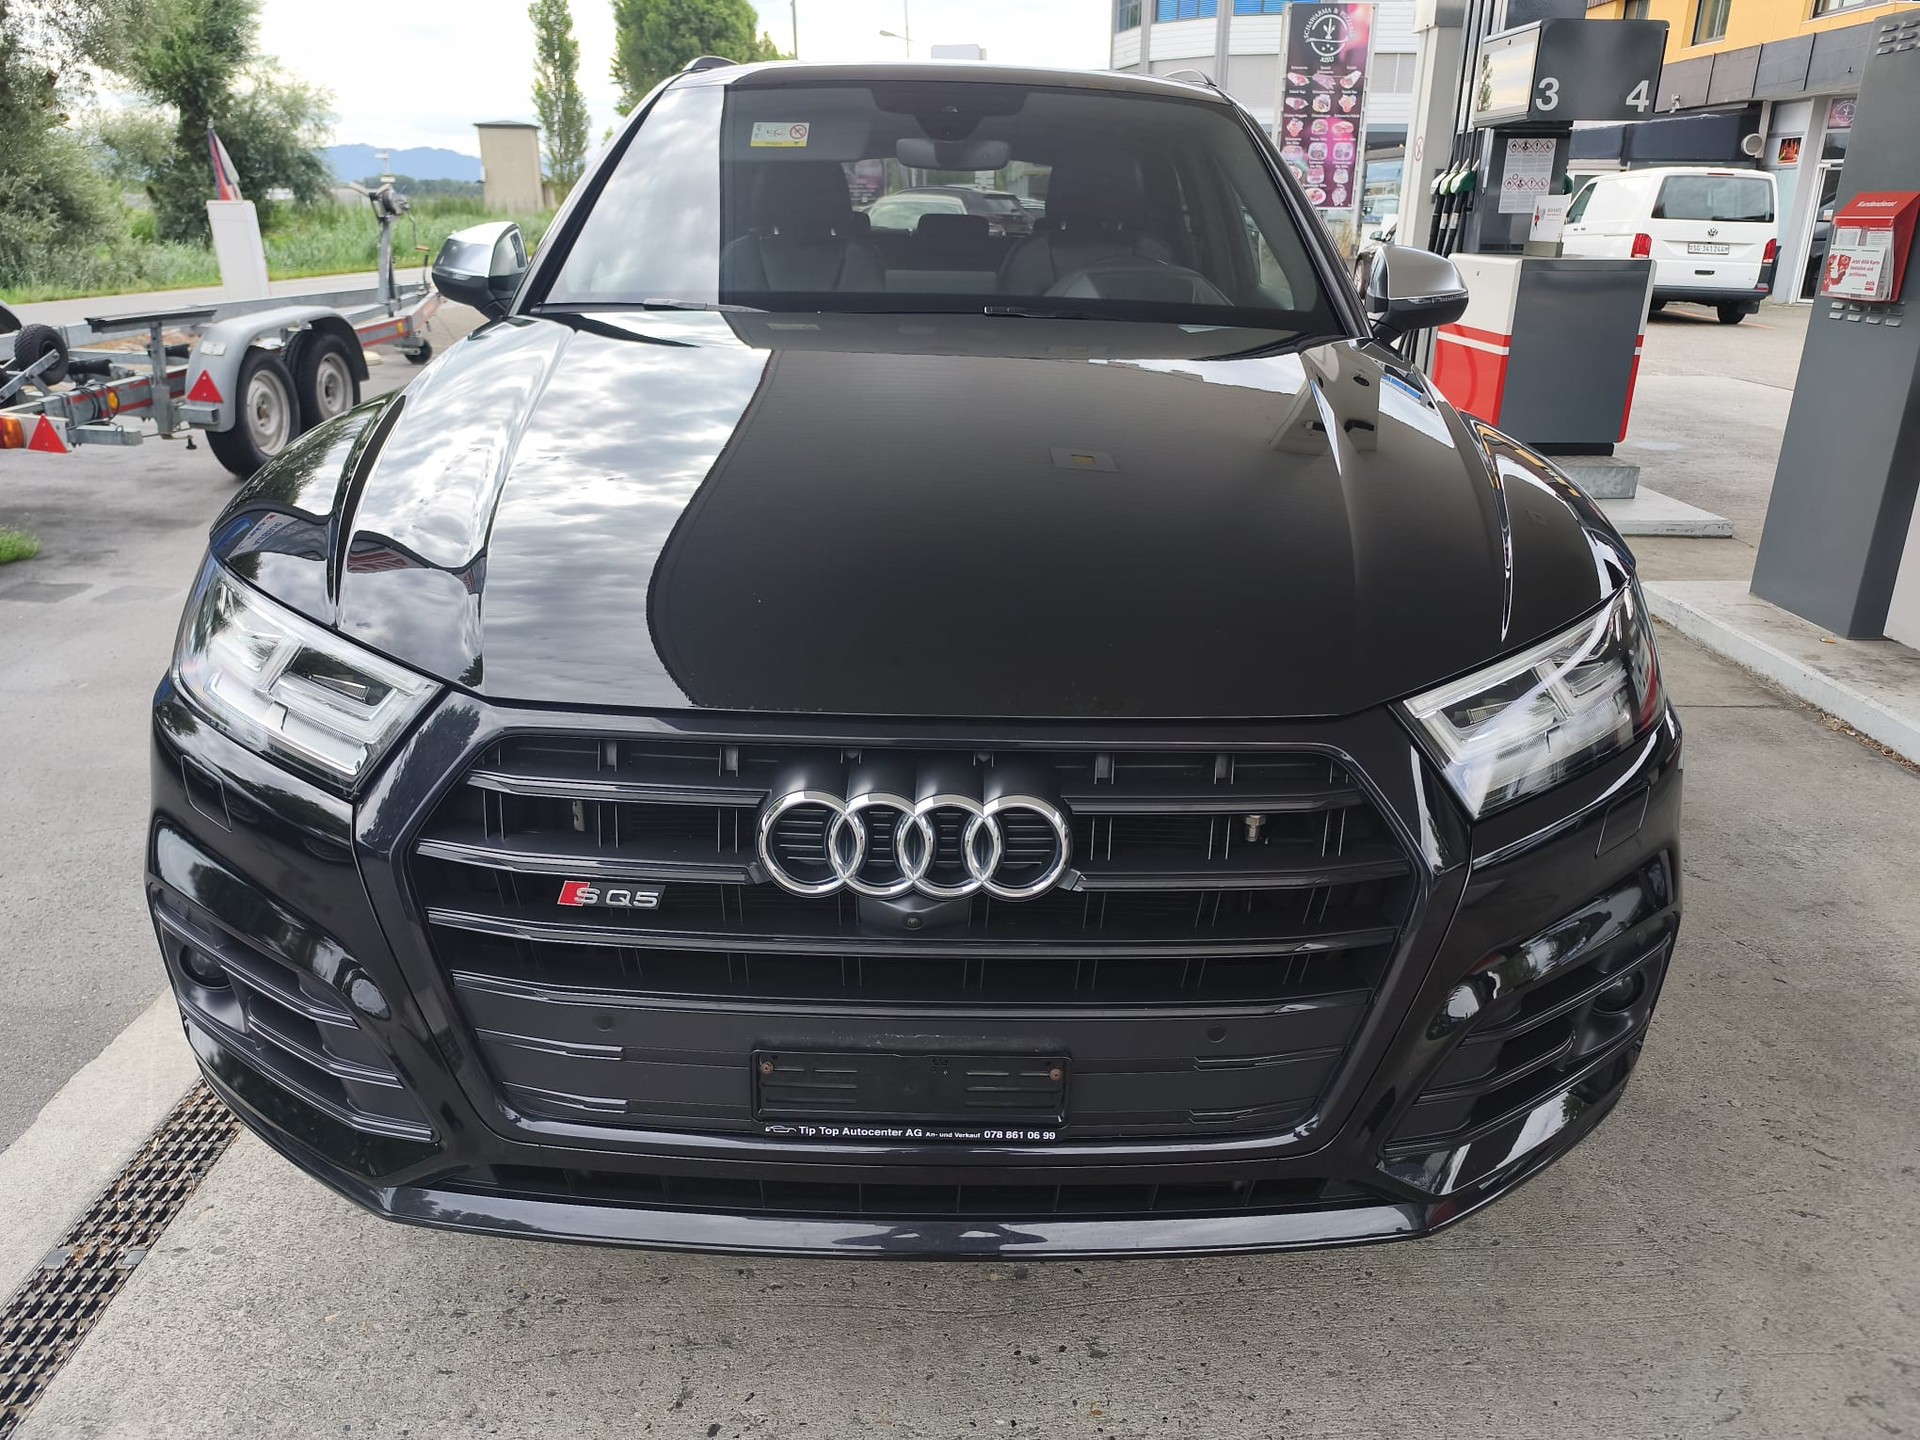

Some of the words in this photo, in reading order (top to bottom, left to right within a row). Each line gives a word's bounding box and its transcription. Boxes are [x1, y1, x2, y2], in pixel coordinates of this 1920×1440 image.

[1535, 77, 1560, 111] 3
[1625, 80, 1650, 112] 4
[799, 1125, 816, 1137] Tip
[819, 1126, 839, 1137] Top
[842, 1127, 903, 1137] Autocenter
[905, 1128, 923, 1137] AG
[984, 1130, 1003, 1139] 078
[1005, 1130, 1024, 1139] 861
[1027, 1131, 1040, 1139] 06
[1043, 1131, 1056, 1140] 99
